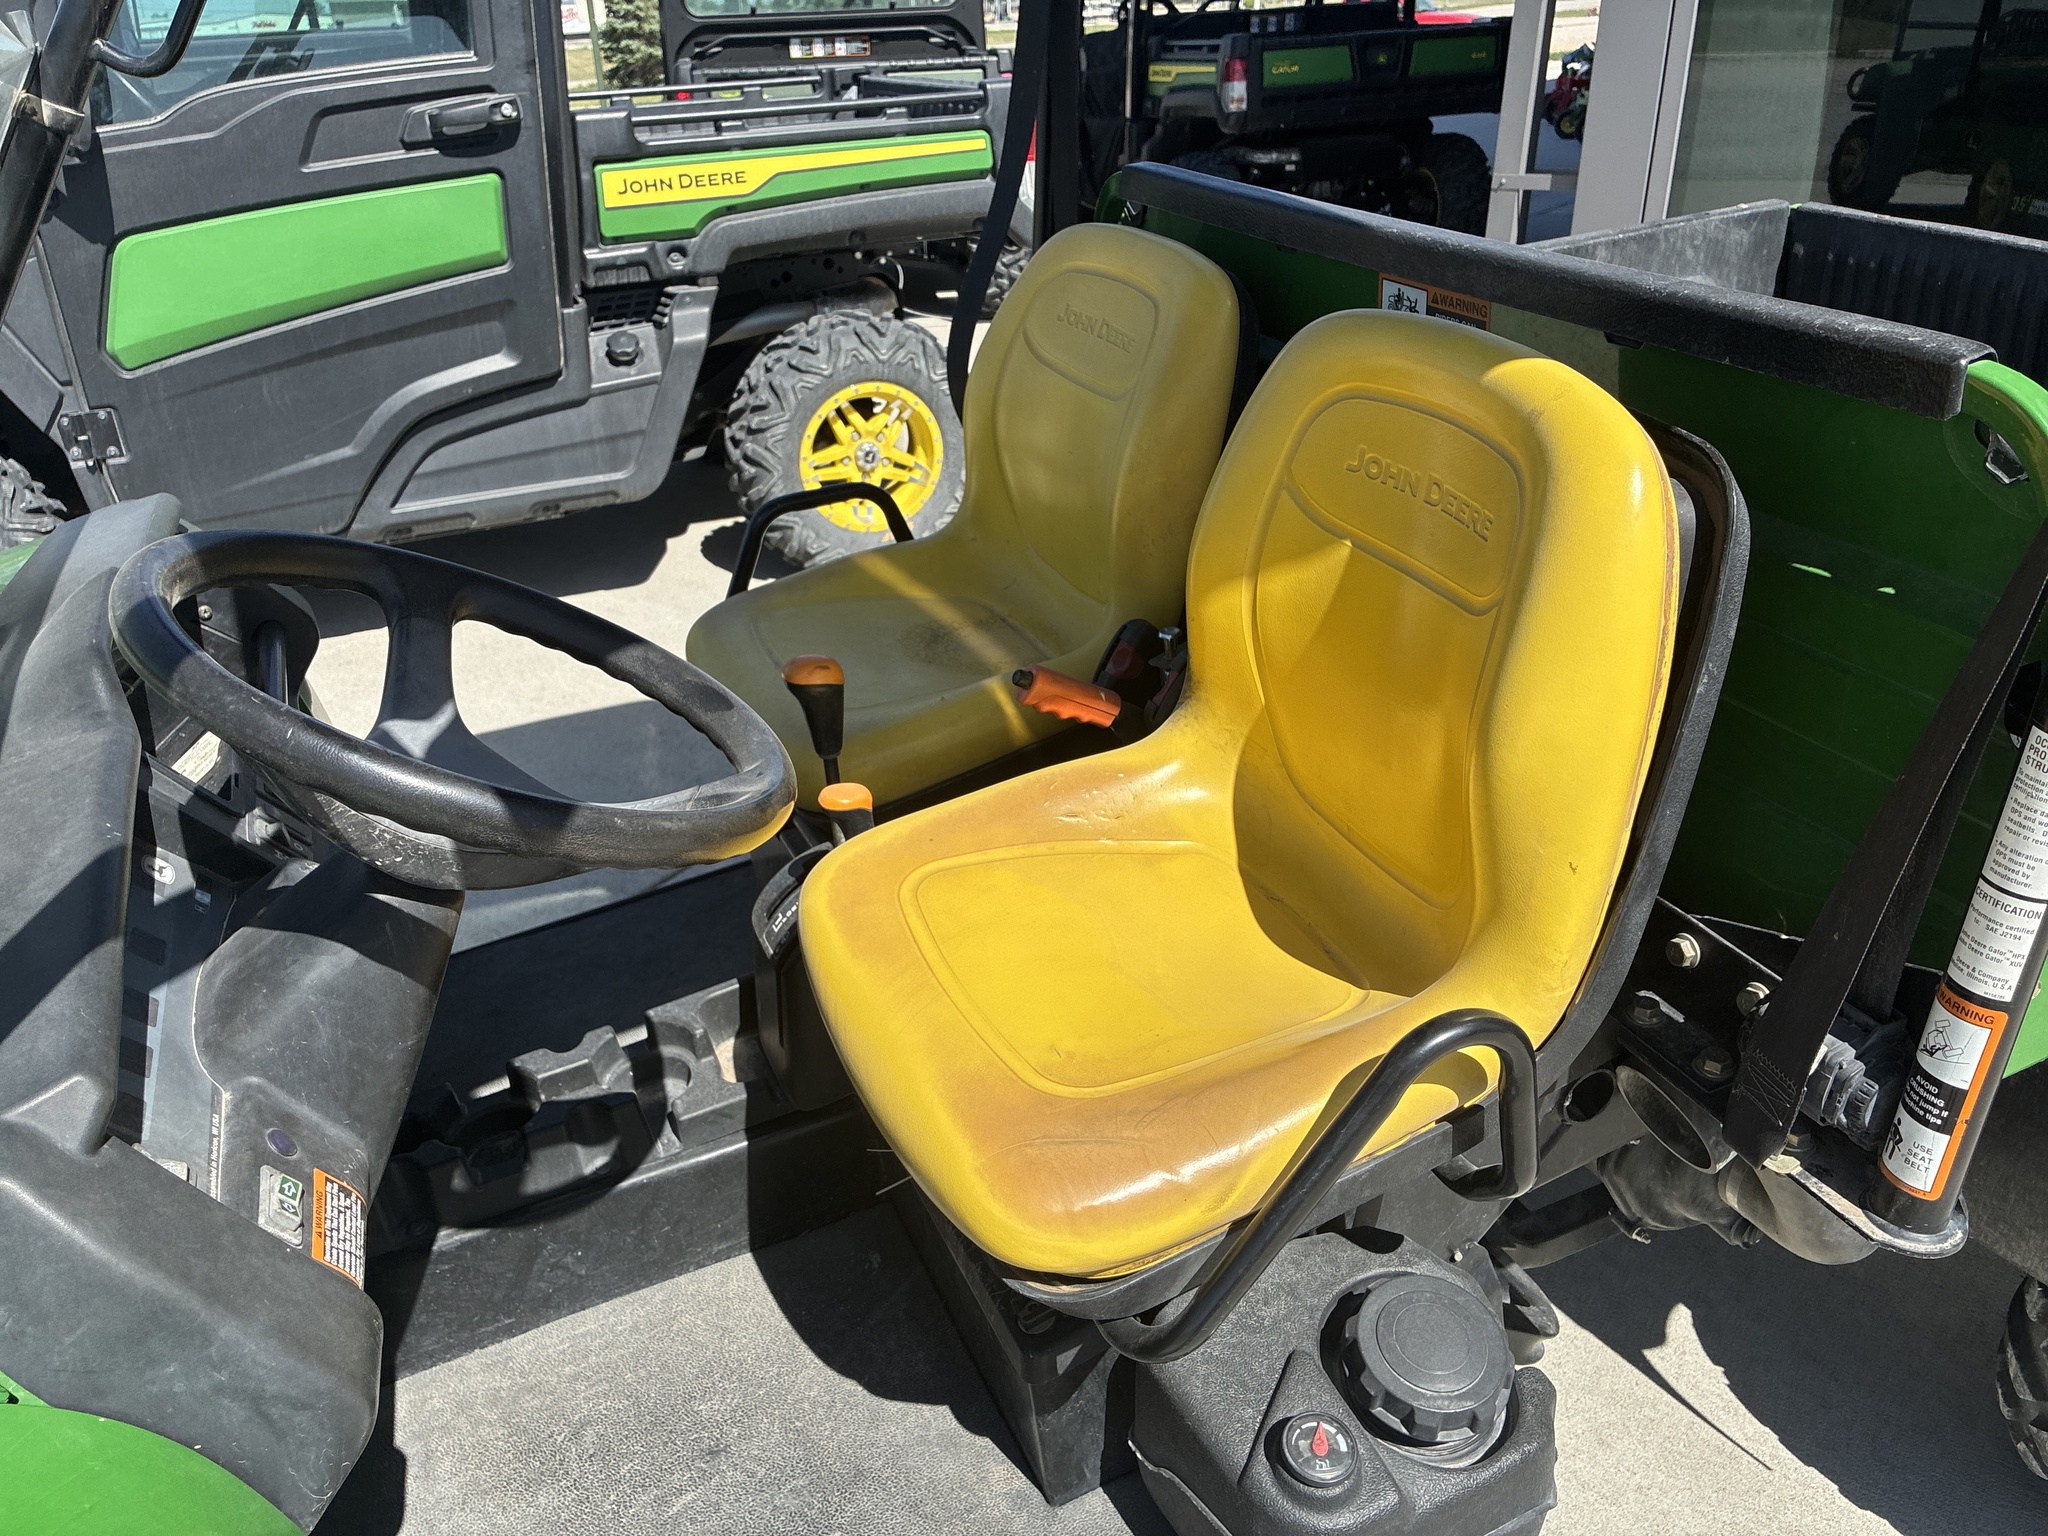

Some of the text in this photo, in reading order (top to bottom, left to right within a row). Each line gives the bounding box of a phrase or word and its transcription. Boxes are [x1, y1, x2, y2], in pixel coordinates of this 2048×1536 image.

[618, 170, 747, 195] JOHN DEERE
[1439, 292, 1488, 319] WARNING
[1056, 302, 1136, 354] JOHN DEERE
[1345, 445, 1494, 543] JOHN DEERE
[2013, 797, 2038, 815] Replace
[2023, 814, 2037, 824] and
[2004, 824, 2021, 838] repair
[2022, 834, 2031, 842] or
[1998, 840, 2009, 852] Any
[2009, 847, 2044, 864] alteration
[1992, 857, 2031, 881] approved by
[2007, 857, 2026, 868] must
[2026, 863, 2036, 872] be
[1989, 866, 2033, 889] manufacturer.
[1975, 885, 2043, 921] CERTIFICATION
[1969, 902, 2036, 935] Performance certified
[1984, 923, 1999, 935] SAE
[1999, 930, 2022, 941] J2194
[1967, 942, 1984, 957] Deere
[2009, 959, 2024, 968] XUV
[1970, 935, 1987, 950] Deere
[2012, 952, 2027, 961] HPX
[1956, 955, 2010, 985] Deere & Company
[1939, 990, 1995, 1025] WARNING
[1910, 1076, 1945, 1107] CRUSHING
[1915, 1074, 1939, 1094] AVOID
[1909, 1090, 1919, 1102] not
[1918, 1098, 1940, 1115] jump
[212, 1113, 220, 1127] USA
[1925, 1113, 1942, 1125] tips
[1906, 1148, 1934, 1165] SEAT
[1912, 1141, 1934, 1156] USE
[1903, 1157, 1930, 1174] BELT
[315, 1189, 324, 1229] WARNING
